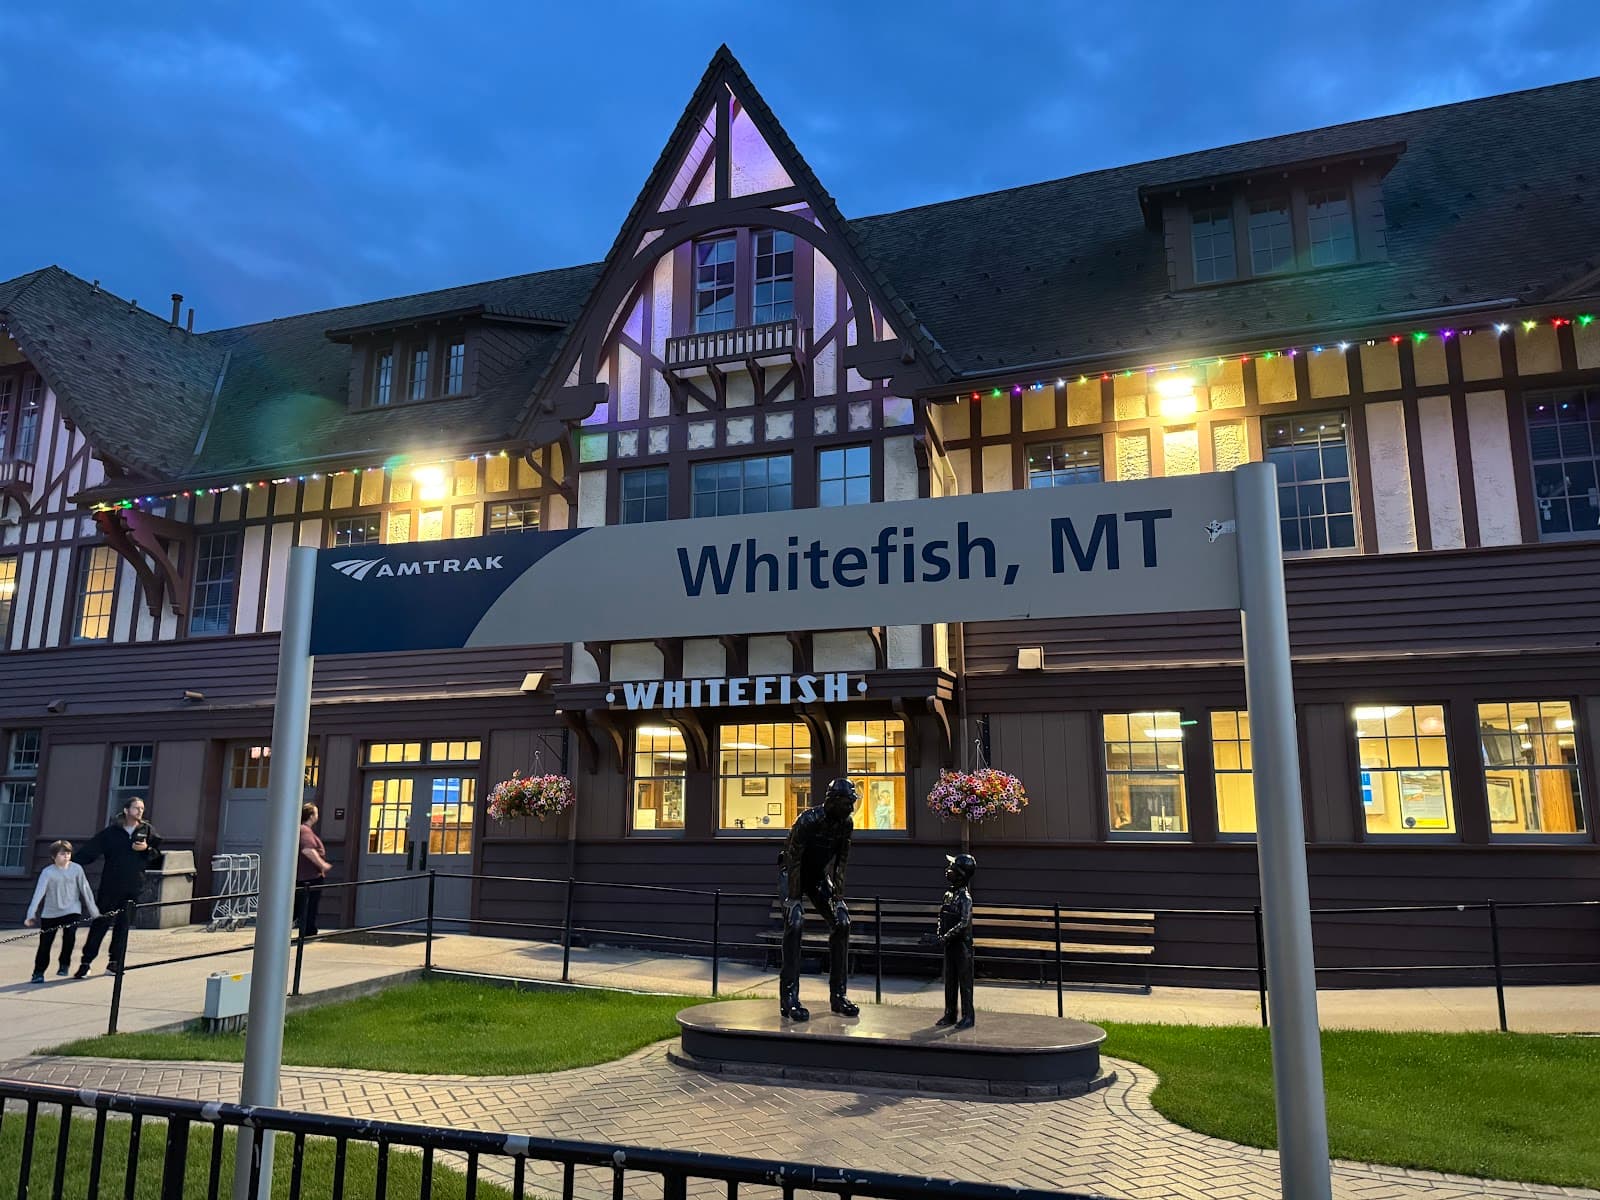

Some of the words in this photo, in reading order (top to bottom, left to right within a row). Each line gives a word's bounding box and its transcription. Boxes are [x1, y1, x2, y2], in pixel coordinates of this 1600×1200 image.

[375, 555, 505, 579] AMTRAK
[676, 521, 1020, 597] Whitefish,
[1050, 508, 1173, 575] MT
[623, 672, 849, 710] WHITEFISH
